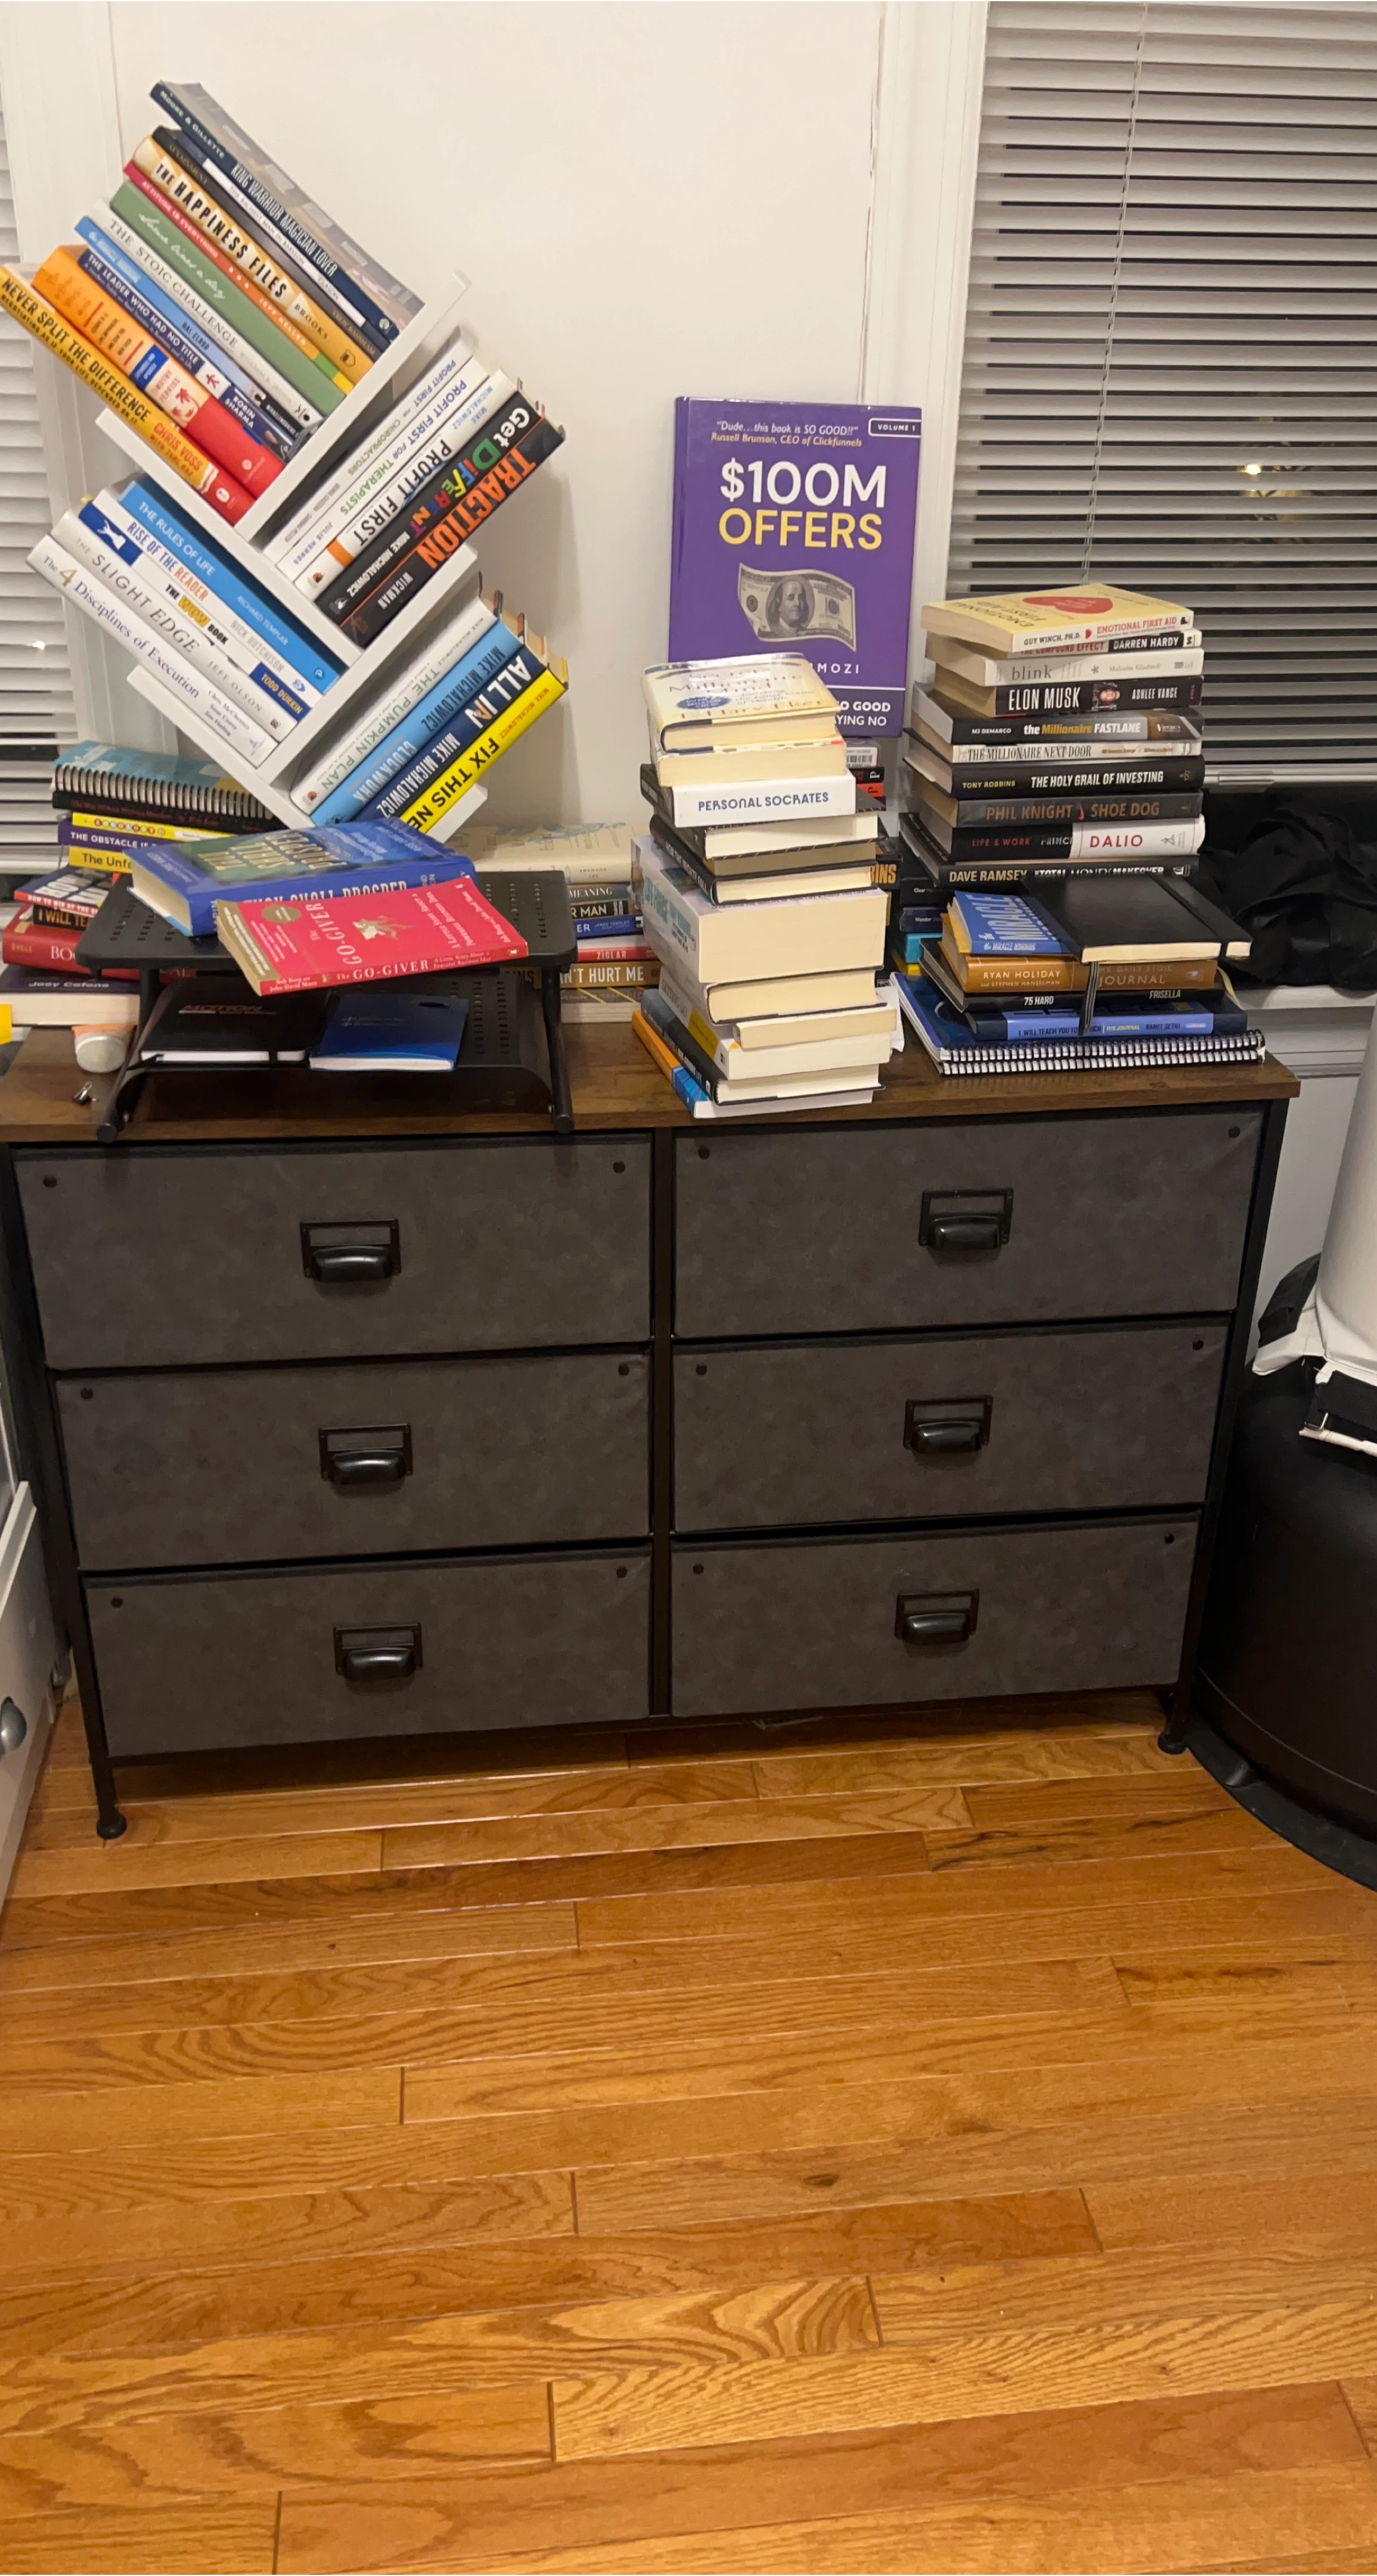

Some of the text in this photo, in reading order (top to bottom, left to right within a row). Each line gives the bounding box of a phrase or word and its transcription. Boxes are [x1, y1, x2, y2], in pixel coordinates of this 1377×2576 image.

[156, 163, 175, 185] THE
[174, 181, 248, 258] HAPPINESS
[249, 258, 287, 298] FILES
[231, 162, 338, 278] KING WARRIOR MAGICIAN LOVER
[110, 219, 132, 243] THE
[137, 246, 172, 283] STOIC
[172, 281, 238, 349] CHALLENGE
[88, 255, 199, 364] THE LEADER WHO HAD NO TITLE
[294, 302, 328, 339] BROOKS
[2, 278, 39, 314] NEVER
[38, 312, 69, 344] SPLIT
[69, 339, 91, 365] THE
[89, 360, 151, 423] DIFFERENCE
[432, 360, 456, 389] PROFIT
[392, 379, 467, 460] PROFIT FIRST FOR
[492, 407, 531, 448] Get
[771, 423, 816, 434] book is SO
[153, 422, 203, 472] CHRIS VOSS
[711, 432, 862, 447] Russell CEO of Clickfunnels
[340, 459, 395, 515] THERAPISTS
[352, 439, 454, 547] PROFIT FIRST
[720, 457, 887, 508] $100M
[416, 447, 536, 569] TRACTION
[139, 501, 216, 576] THE RULES OF LIFE
[719, 508, 883, 550] OFFERS
[126, 521, 209, 602] RISE OF THE READER
[346, 530, 411, 597] MIKE MICHALOWICZ
[377, 571, 414, 609] WICKMAN
[92, 555, 200, 653] SLIGHT EDGE
[165, 584, 228, 645] THE WOW BOOK
[43, 555, 199, 699] The 4 Disciplines of Execution
[263, 618, 289, 646] TEMPLAR
[1097, 622, 1141, 634] EMOTIONAL
[1143, 618, 1163, 628] FIRST
[1165, 617, 1178, 626] AID
[1024, 637, 1037, 646] GUY
[1077, 642, 1104, 652] EFFECT
[1114, 636, 1179, 649] DARREN HARDY
[486, 655, 532, 701] ALL
[1012, 665, 1053, 681] blink
[231, 682, 263, 711] OLSON
[421, 645, 505, 733] MIKE MICHALOWICZ
[1009, 687, 1081, 711] ELON MUSK
[1132, 688, 1178, 699] ASHLEE VANCE
[278, 689, 303, 714] DURKIN
[853, 701, 891, 712] GOOD
[321, 667, 439, 790] THE PUMPKIN PLAN
[868, 716, 886, 726] NO
[1024, 722, 1142, 735] the Millionaire FASTLANE
[968, 748, 984, 761] THE
[987, 747, 1041, 760] MILLIONAIRE
[1044, 745, 1066, 758] NEXT
[1068, 745, 1091, 757] DOOR
[352, 740, 417, 804] CLOCKWORK
[376, 732, 461, 819] MIKE MICHALOWICZ
[431, 737, 500, 808] FIX THIS
[1031, 770, 1164, 788] THE HOLY GRAIL OF INVESTING
[698, 792, 829, 812] PERSONAL SOCRATES
[986, 804, 1073, 821] PHIL KNIGHT
[1090, 802, 1160, 818] SHOE DOG
[70, 832, 138, 848] THE OBSTACLE
[1090, 835, 1143, 848] DALIO
[82, 853, 103, 865] The
[949, 869, 1028, 883] DAVE RAMSEY
[568, 887, 613, 899] MEANING
[46, 910, 72, 925] WILL
[581, 904, 607, 918] MAN
[305, 902, 362, 965] GO-GIVER
[597, 951, 627, 960] ZIGLAR
[336, 959, 429, 981] The GO-GIVER
[589, 966, 644, 983] HURT ME
[984, 970, 1060, 979] RYAN HOLIDAY
[1146, 964, 1174, 972] STOIC
[1099, 975, 1166, 987] JOURNAL
[1024, 996, 1054, 1005] 75 HARD
[1149, 990, 1181, 999] FRISELLA
